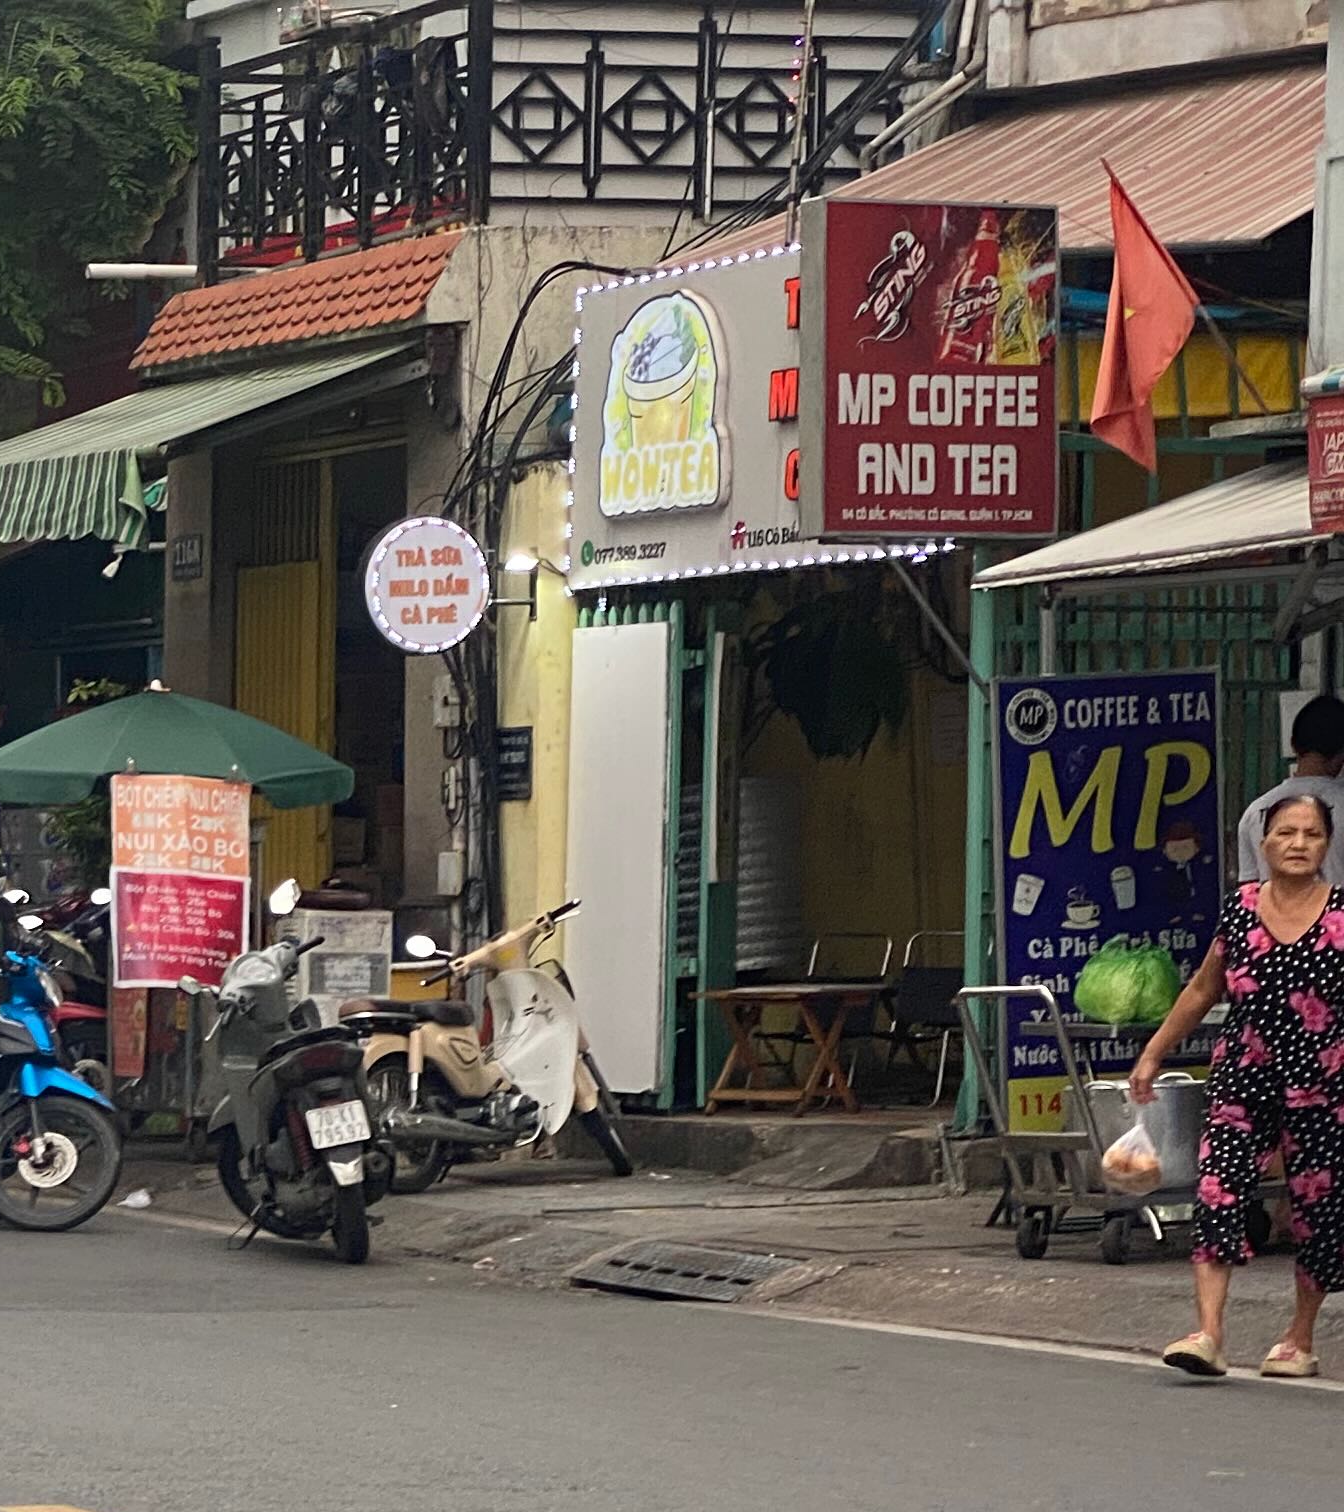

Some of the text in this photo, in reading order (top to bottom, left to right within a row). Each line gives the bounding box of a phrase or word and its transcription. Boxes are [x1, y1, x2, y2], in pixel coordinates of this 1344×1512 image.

[874, 241, 927, 321] STING
[954, 288, 1002, 318] STING
[838, 372, 1039, 427] MP COFFEE
[857, 443, 1018, 496] AND TEA
[1019, 704, 1044, 727] MP
[1064, 695, 1139, 729] COFFEE
[1146, 697, 1161, 725] &
[1168, 690, 1211, 723] TEA
[1009, 740, 1211, 859] MP
[117, 832, 156, 851] NUI
[1028, 937, 1054, 959] Cà
[1059, 934, 1099, 958] Phê
[1019, 1092, 1062, 1116] 114
